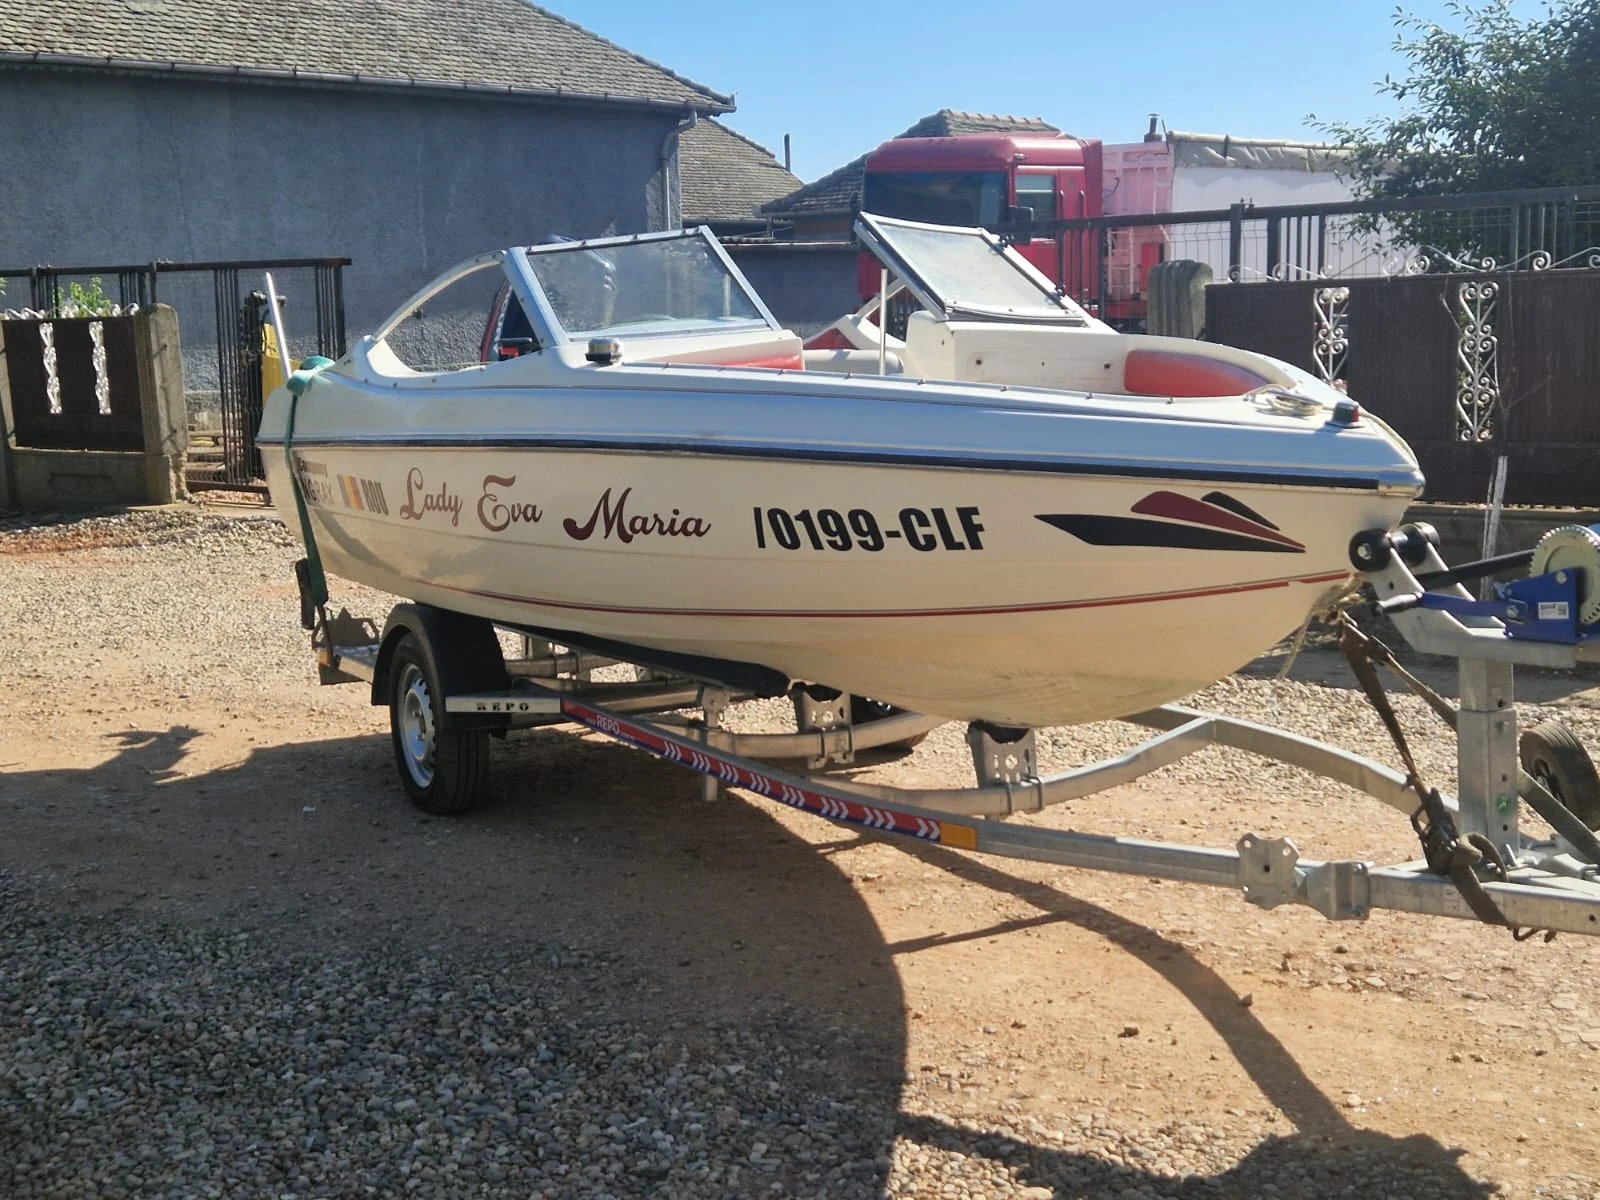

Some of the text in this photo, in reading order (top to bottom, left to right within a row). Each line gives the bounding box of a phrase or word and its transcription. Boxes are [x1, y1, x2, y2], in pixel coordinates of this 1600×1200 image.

[360, 478, 389, 516] ROU
[400, 467, 712, 543] Lady Eva Maria
[476, 702, 529, 711] REPO
[596, 714, 620, 735] REPO
